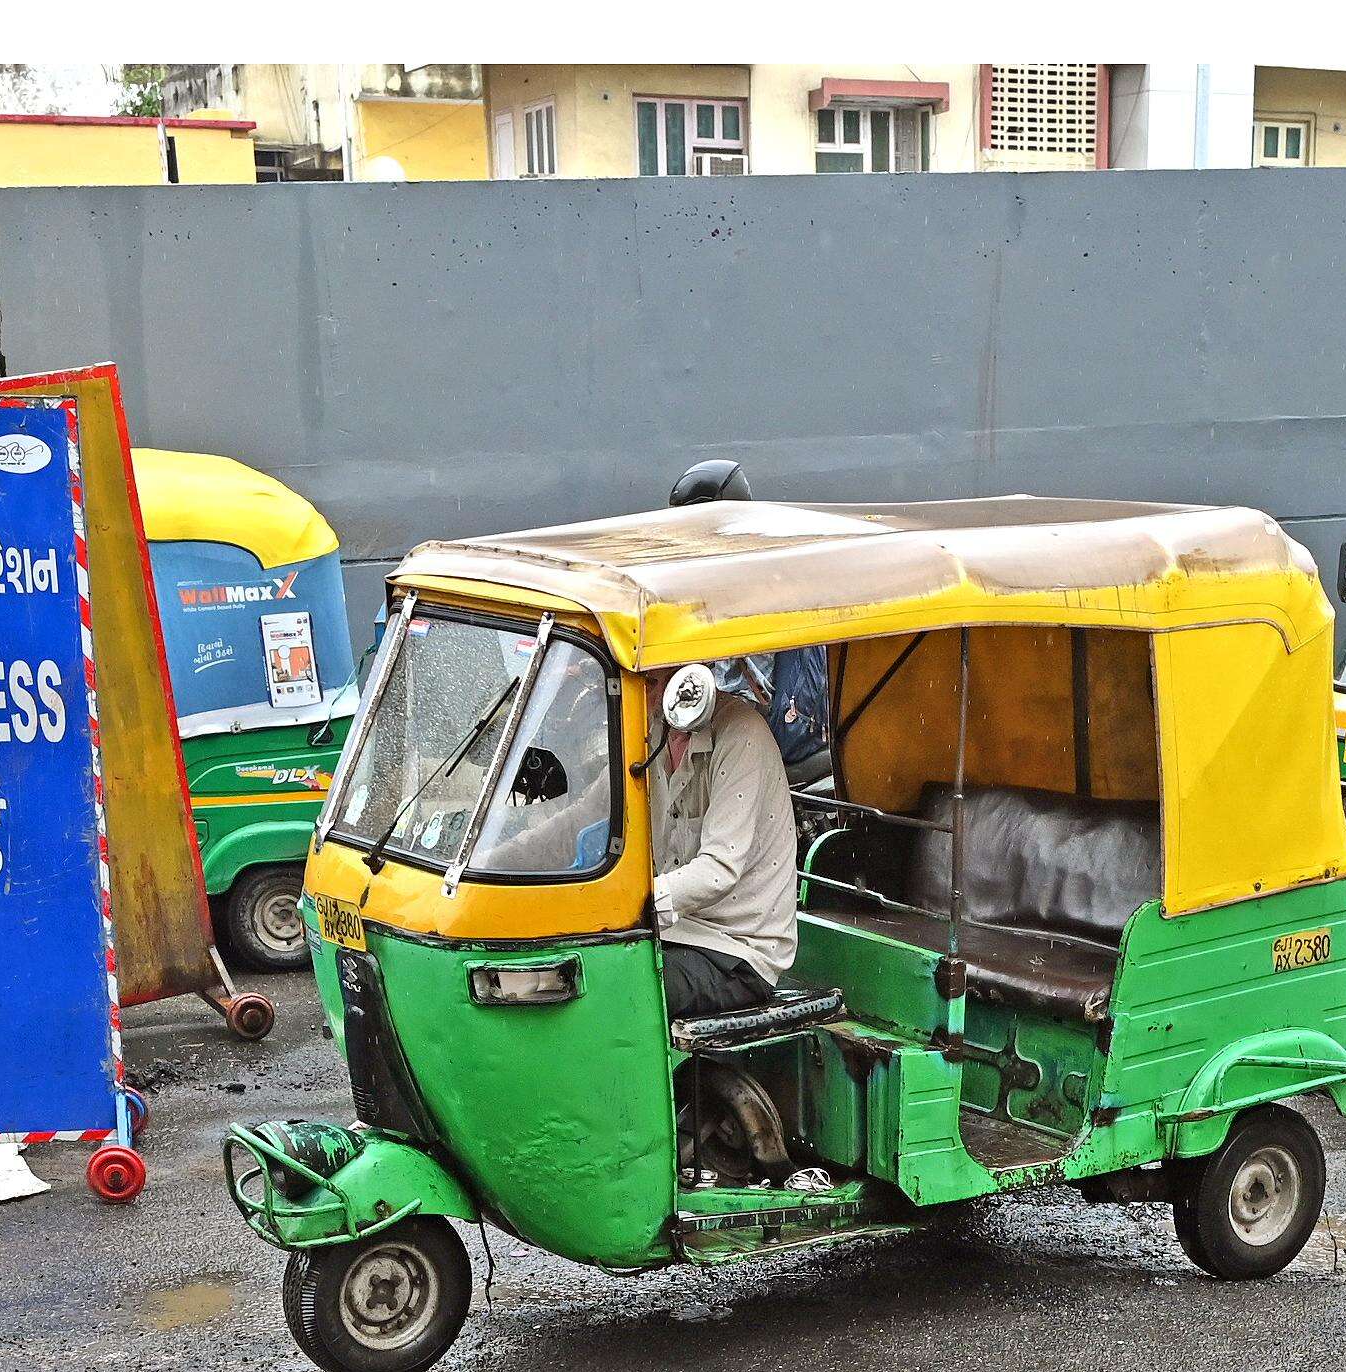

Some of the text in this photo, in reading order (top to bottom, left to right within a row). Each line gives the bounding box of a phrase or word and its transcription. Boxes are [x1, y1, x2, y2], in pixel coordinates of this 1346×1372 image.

[272, 764, 320, 784] DLX
[1295, 934, 1331, 965] 2380
[1274, 952, 1292, 972] AX
